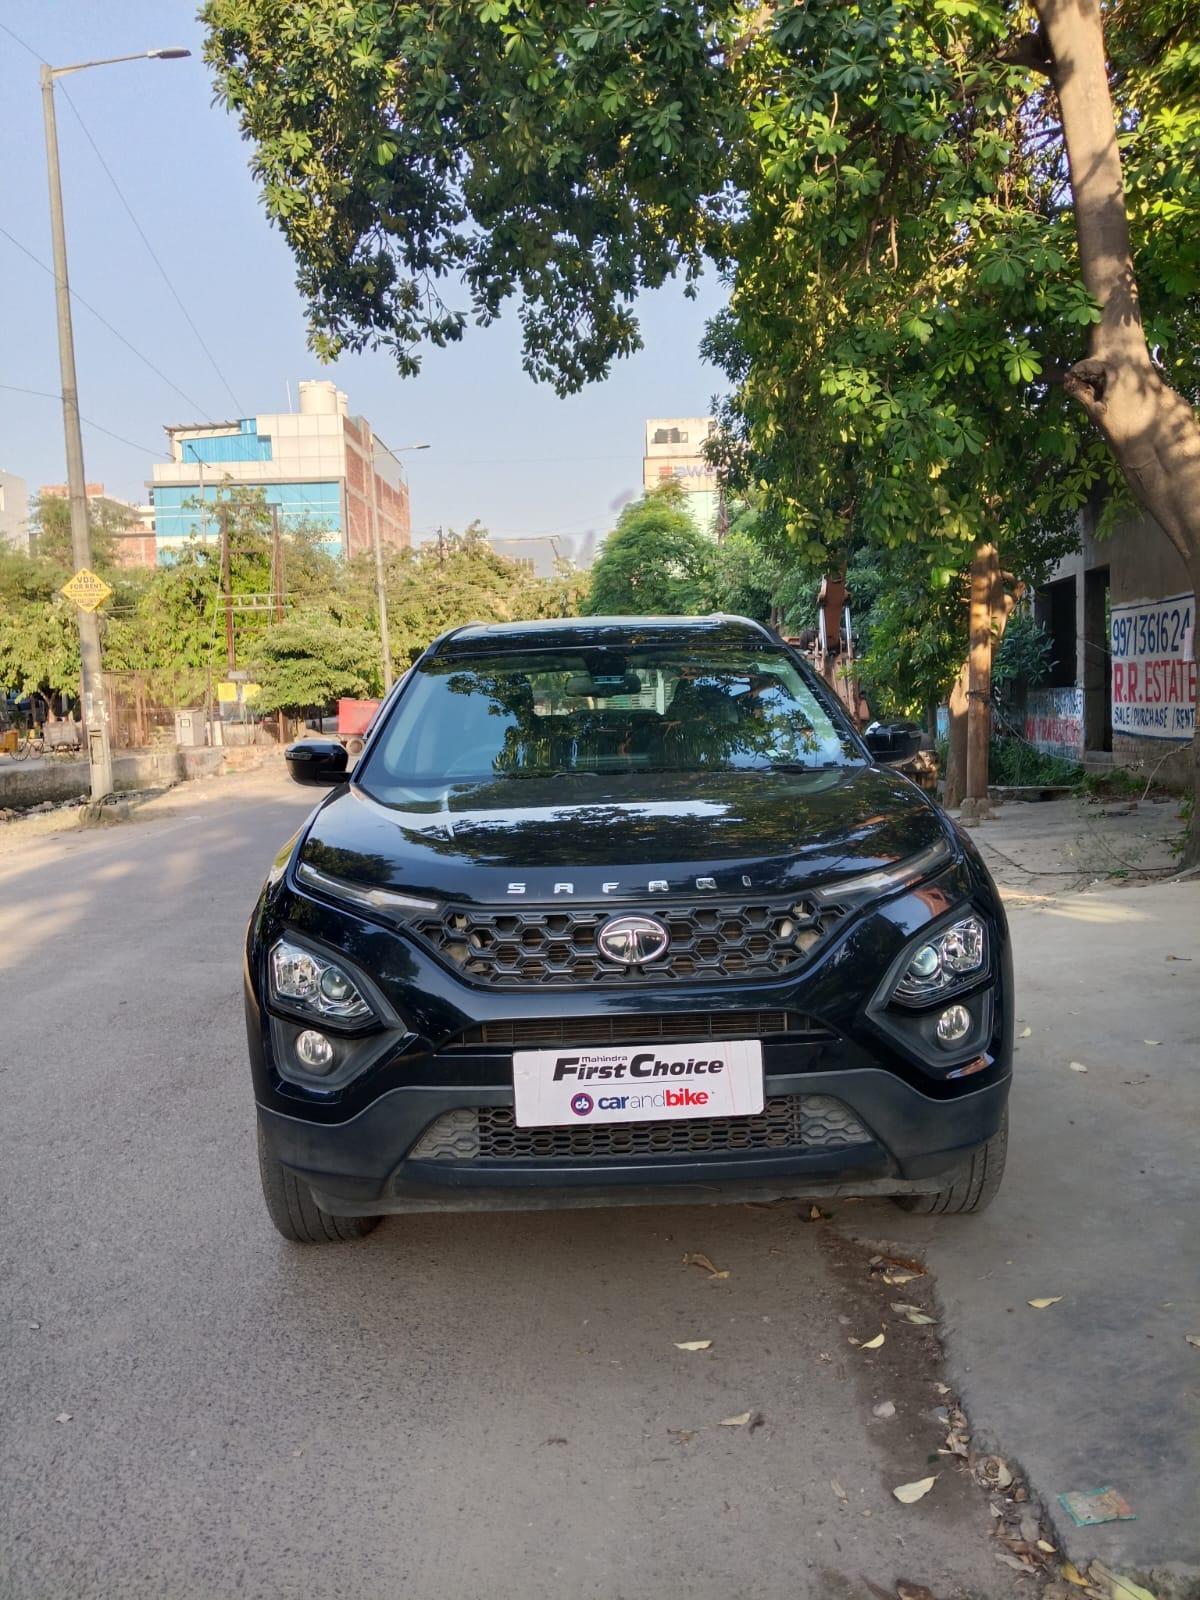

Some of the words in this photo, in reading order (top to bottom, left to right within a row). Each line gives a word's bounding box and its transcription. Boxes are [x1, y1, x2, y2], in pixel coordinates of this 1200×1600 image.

[507, 875, 751, 894] SAFARI
[552, 1056, 627, 1081] First
[629, 1053, 724, 1078] Choice
[581, 1055, 628, 1063] Mahindra
[598, 1088, 708, 1110] carandbike
